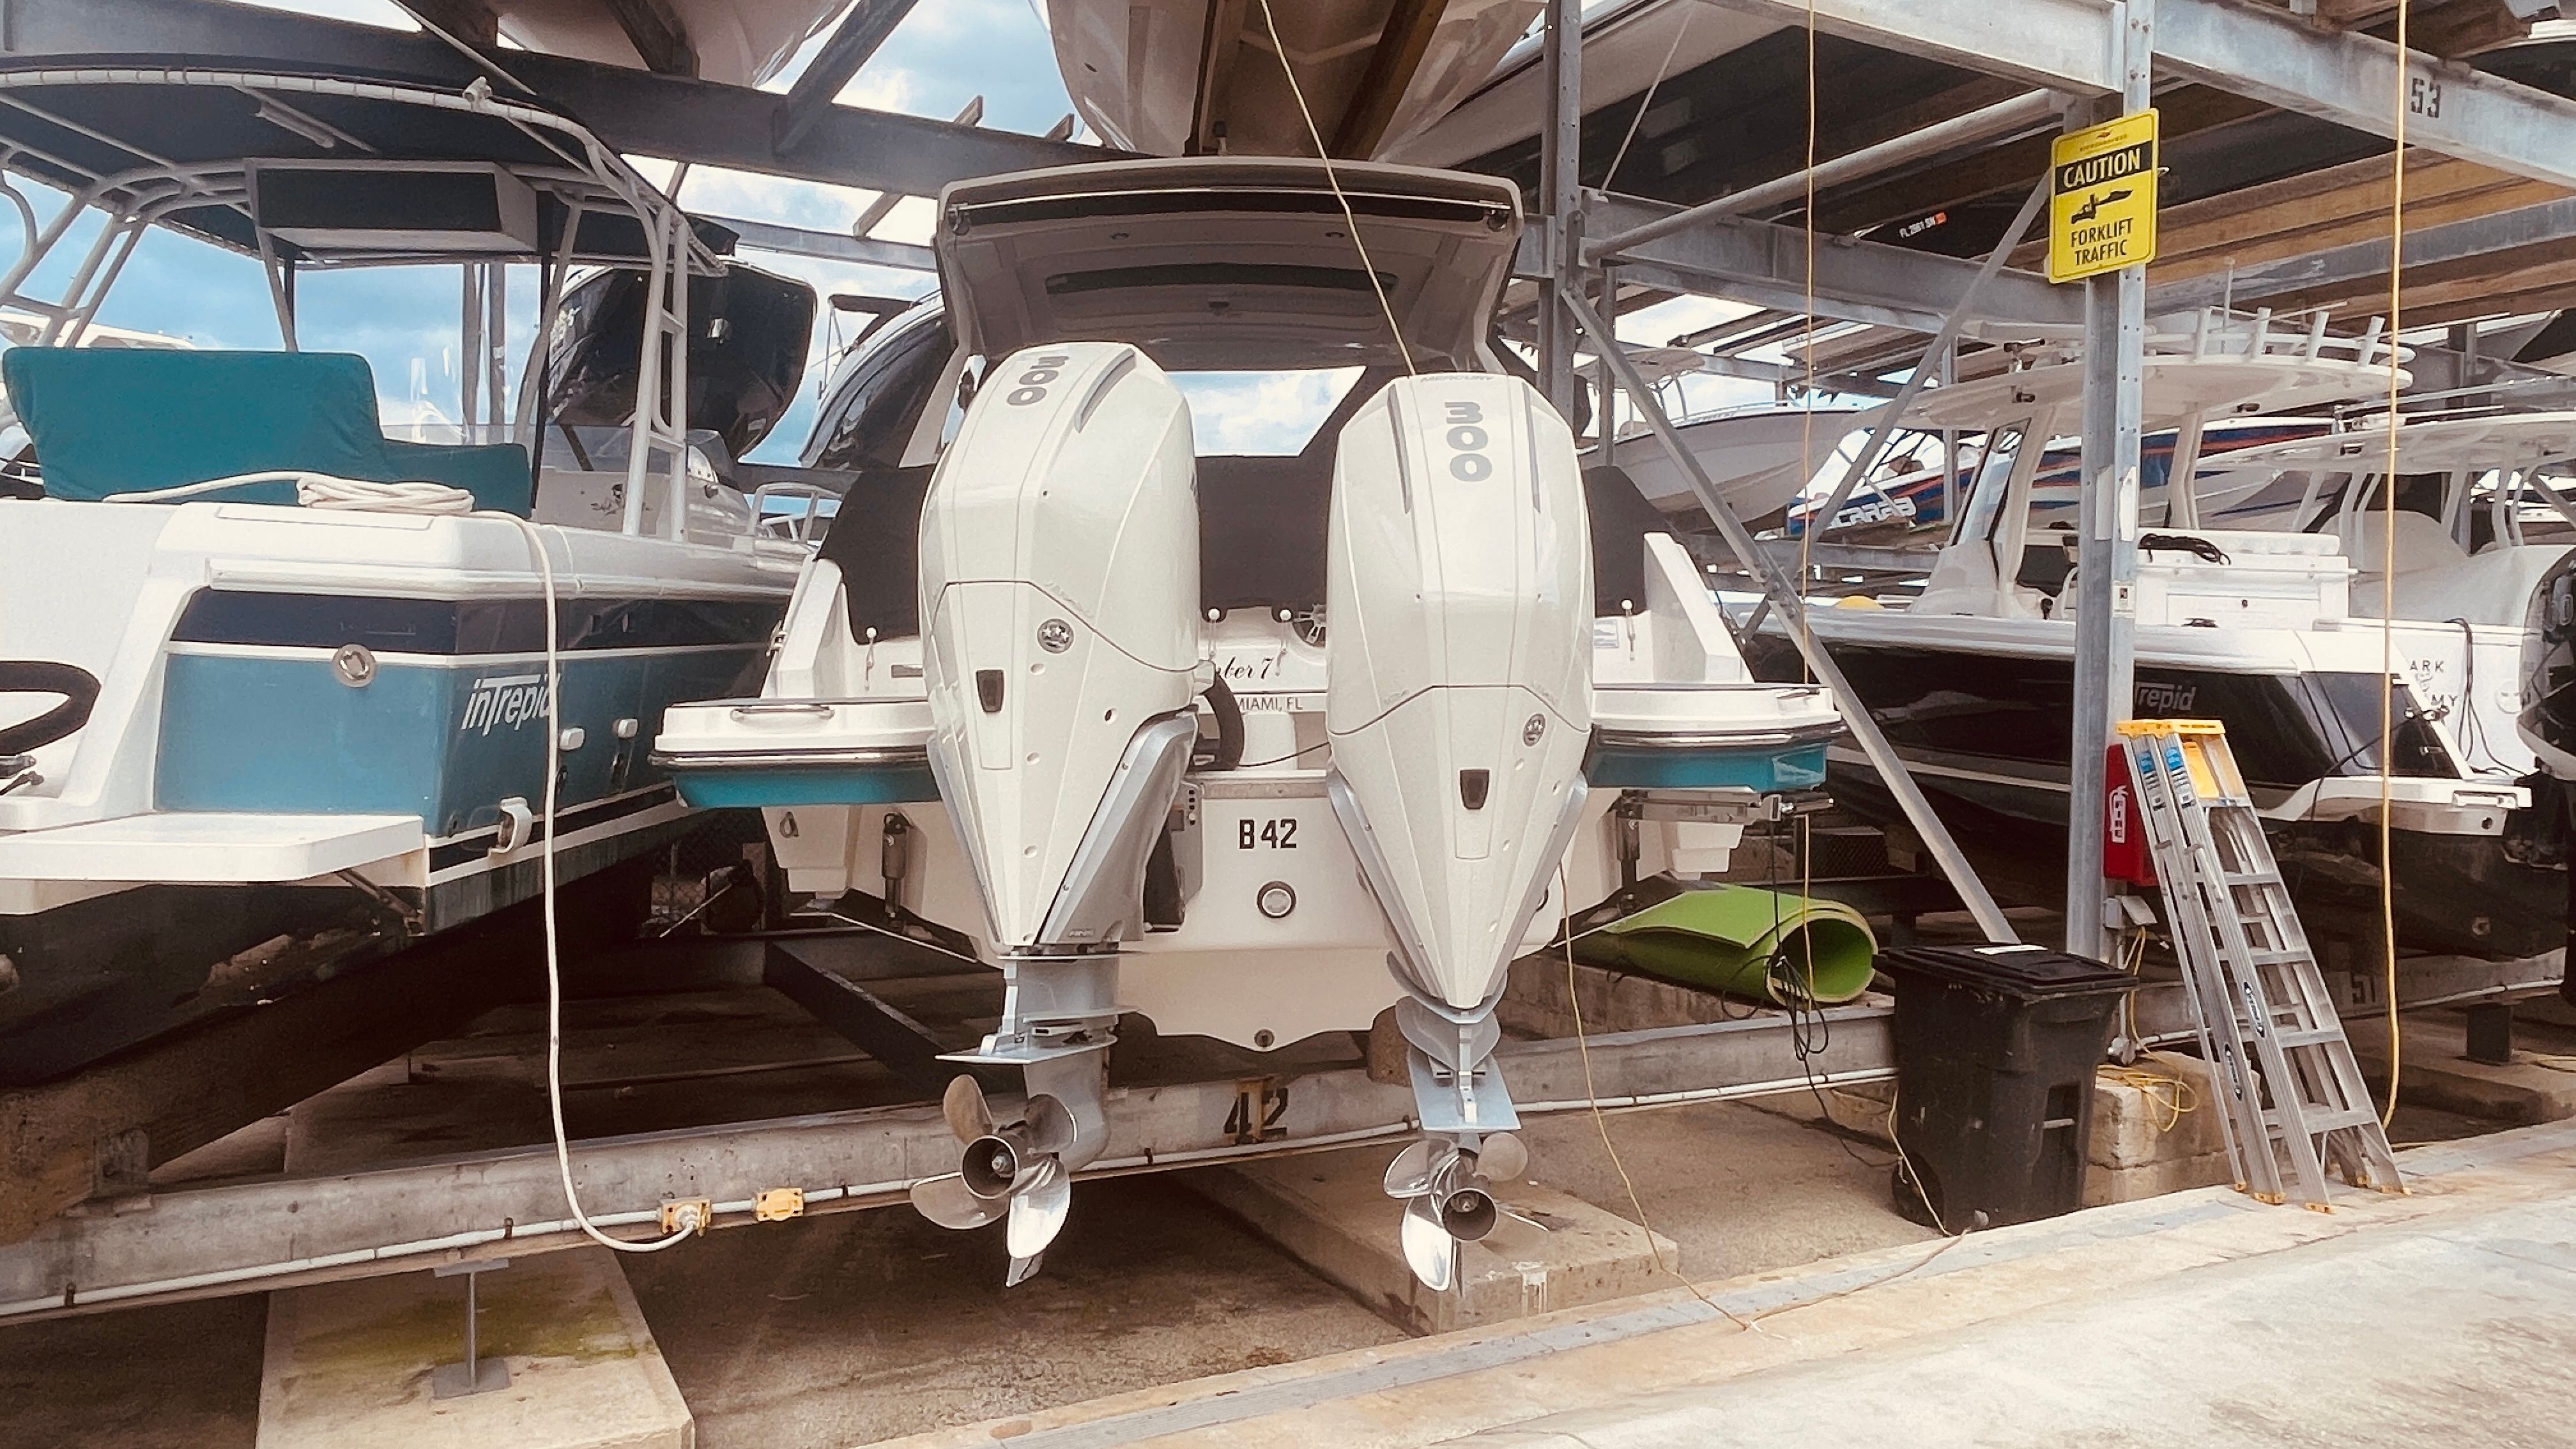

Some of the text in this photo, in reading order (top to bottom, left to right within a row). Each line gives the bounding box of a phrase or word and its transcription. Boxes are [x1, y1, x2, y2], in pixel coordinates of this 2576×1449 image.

[2410, 77, 2441, 119] 53
[2064, 147, 2141, 188] CAUTION
[2070, 217, 2134, 248] FORKLIFT
[2074, 239, 2128, 266] TRAFFIC
[1006, 355, 1070, 406] 300
[1444, 401, 1492, 482] 300
[1826, 497, 1917, 530] CARAB
[1260, 657, 1275, 680] 7
[1287, 696, 1303, 710] FL
[1223, 1087, 1289, 1136] 42
